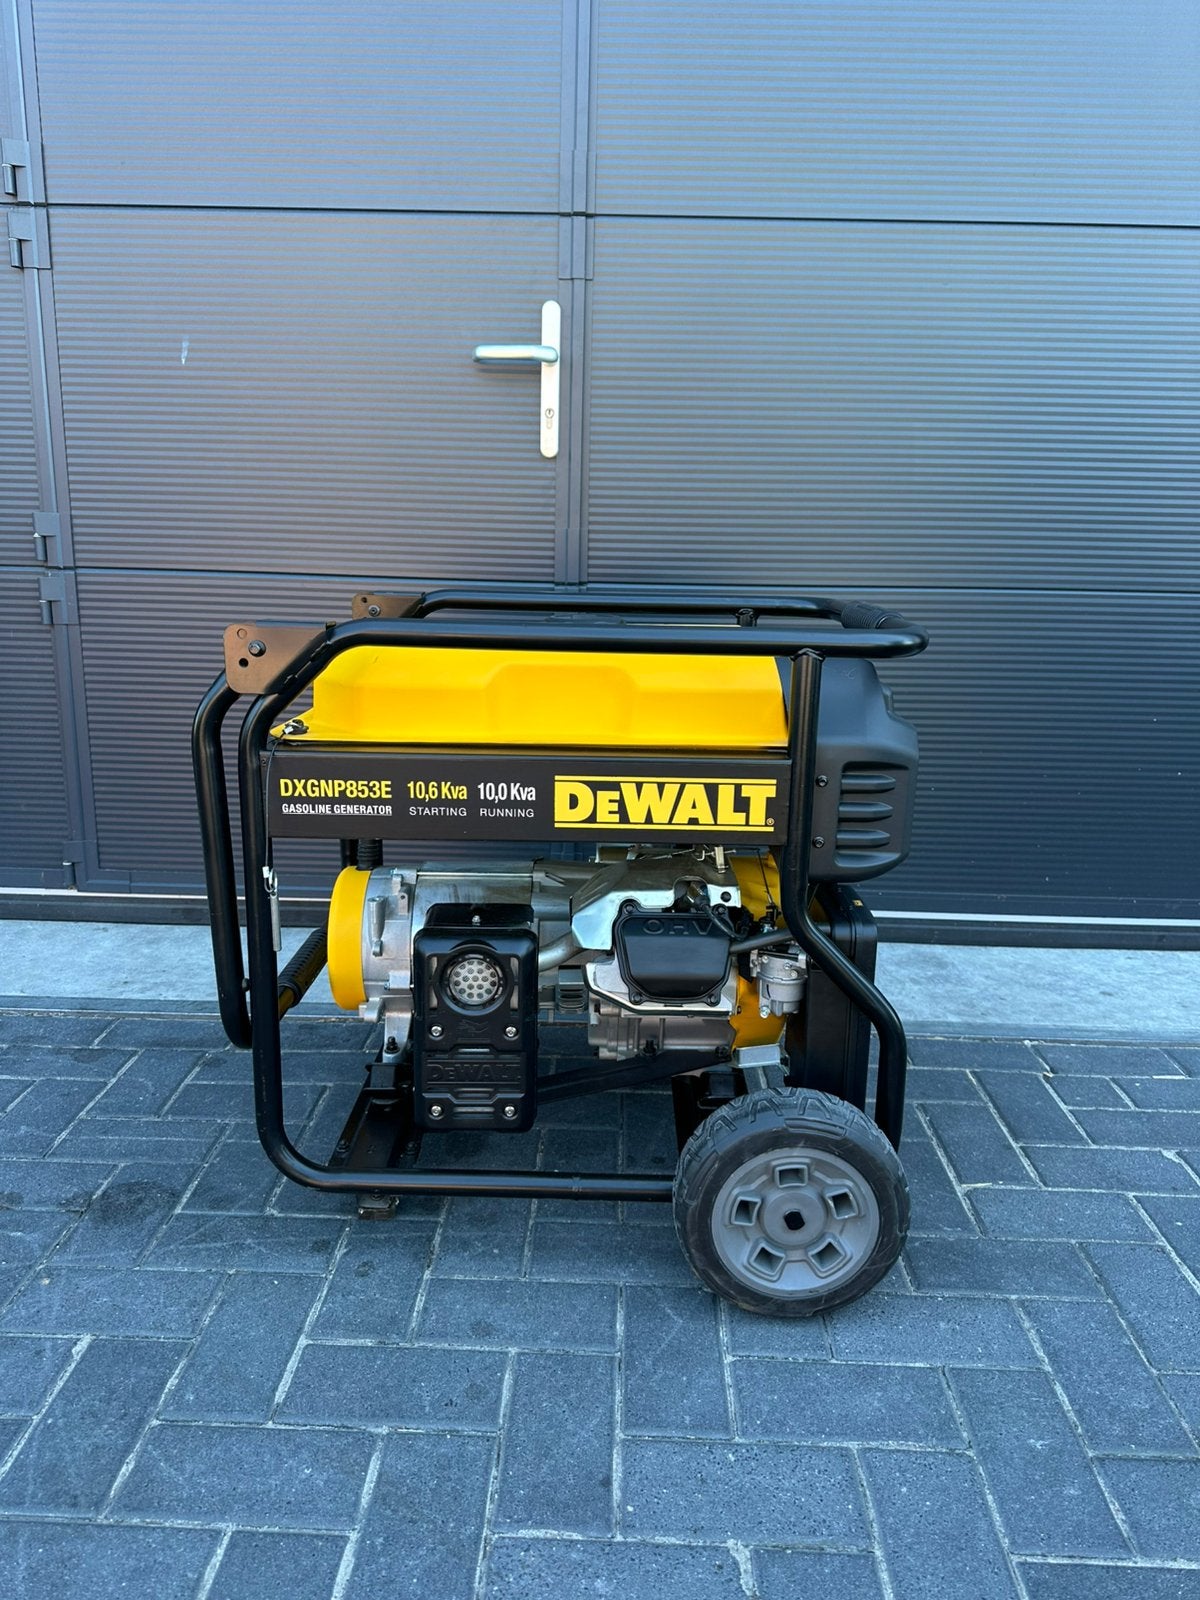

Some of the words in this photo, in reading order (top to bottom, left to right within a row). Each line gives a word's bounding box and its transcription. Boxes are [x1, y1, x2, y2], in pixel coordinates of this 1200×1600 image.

[280, 779, 393, 799] DXGNP853E
[406, 781, 438, 803] 10,6
[441, 782, 468, 800] Kva
[477, 783, 508, 804] 10,0
[510, 784, 537, 802] Kva
[281, 803, 331, 815] GASOLINE
[334, 804, 393, 816] GENERATOR
[409, 806, 467, 817] STARTING
[479, 807, 535, 818] RUNNING
[642, 919, 715, 936] OHV
